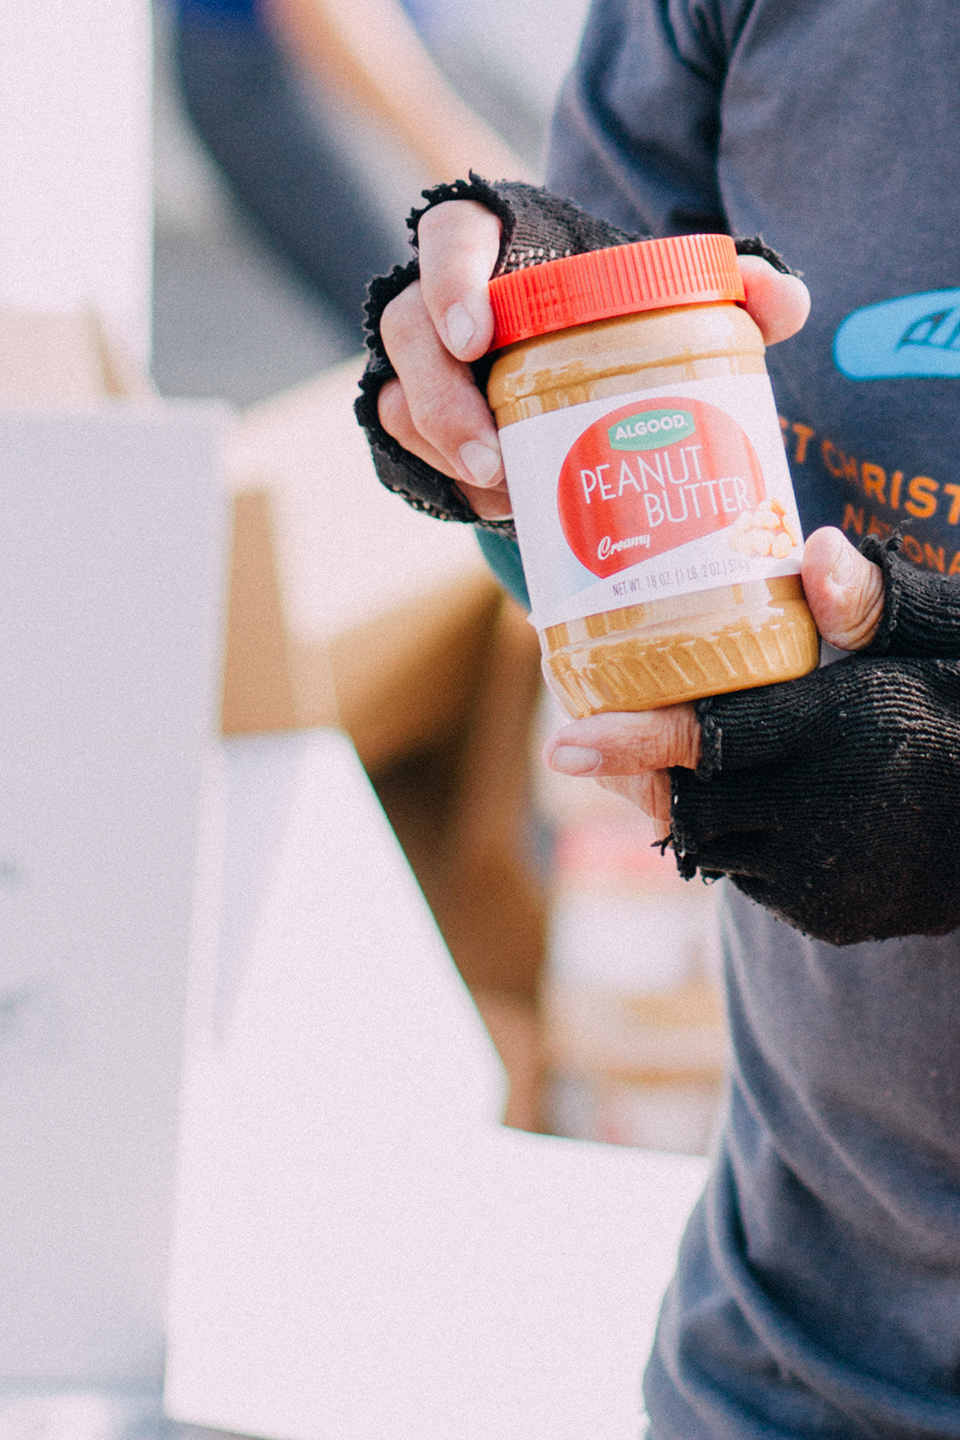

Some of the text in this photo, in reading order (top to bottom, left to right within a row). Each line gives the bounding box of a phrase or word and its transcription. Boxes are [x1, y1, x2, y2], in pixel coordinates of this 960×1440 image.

[580, 445, 702, 504] PEANUT
[643, 476, 751, 528] BUTTER
[597, 534, 651, 561] Creamy
[612, 581, 628, 597] NET
[646, 575, 658, 589] 18
